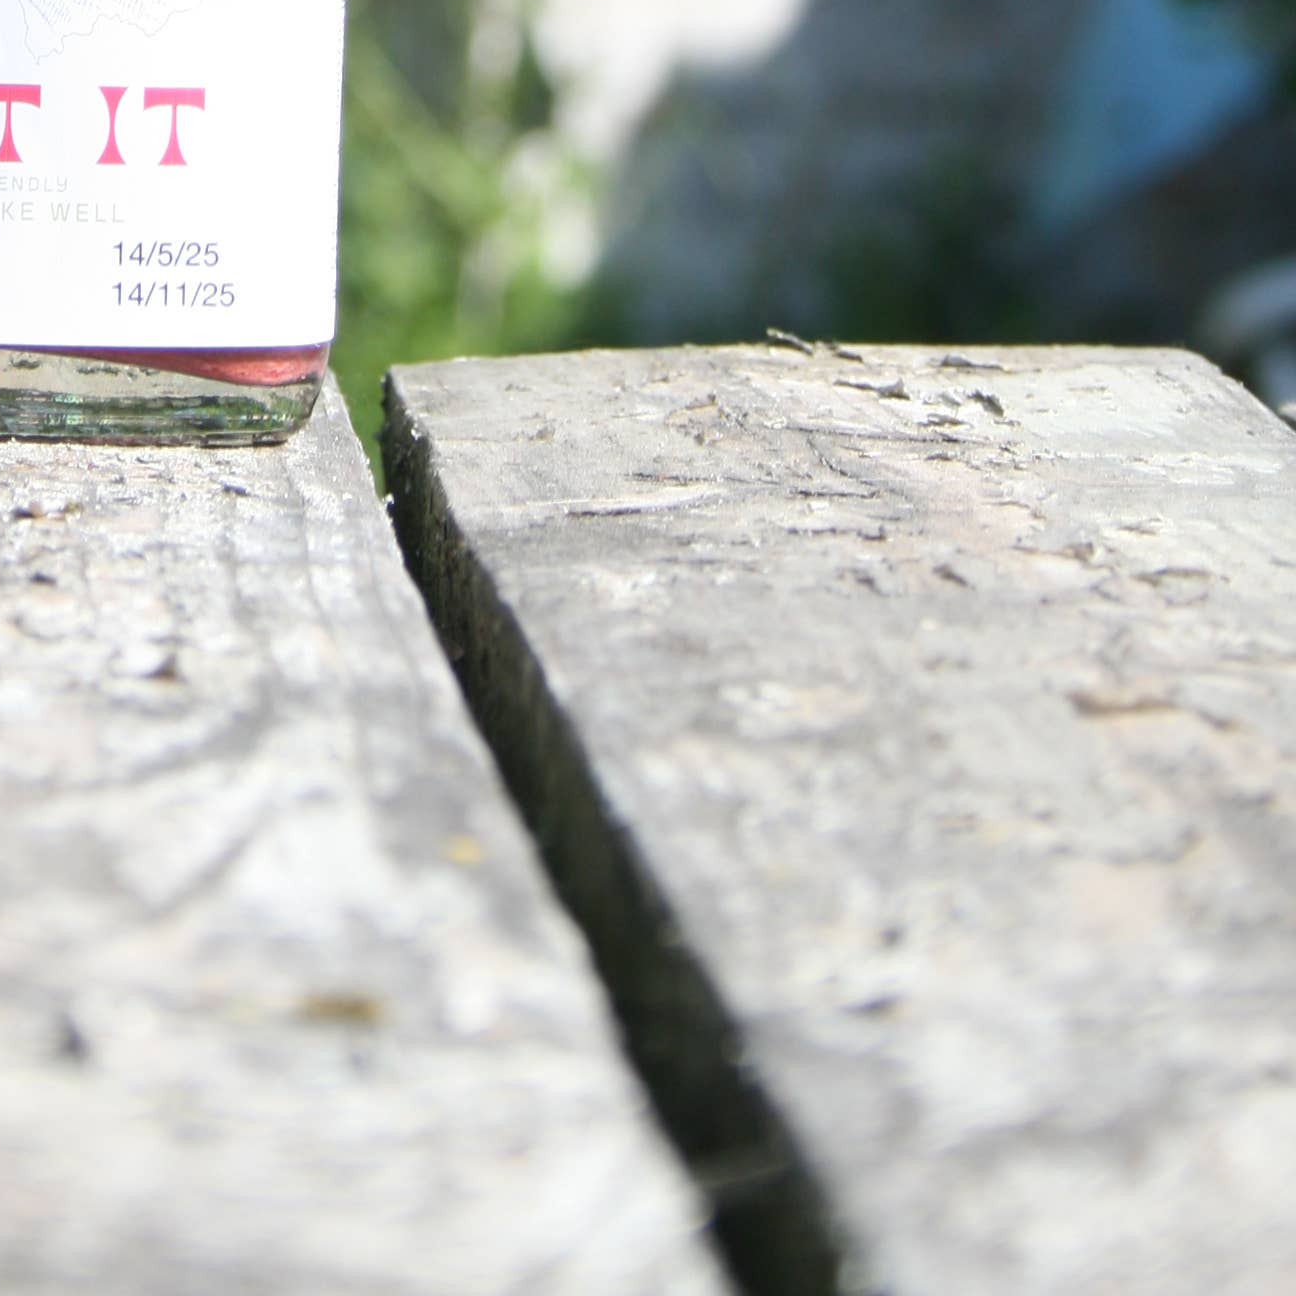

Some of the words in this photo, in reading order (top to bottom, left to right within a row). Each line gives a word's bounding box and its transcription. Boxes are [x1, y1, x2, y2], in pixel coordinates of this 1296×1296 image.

[96, 86, 206, 167] IT
[50, 203, 126, 224] WELL
[113, 241, 219, 267] 14/5/25
[112, 282, 235, 307] 14/11/25
